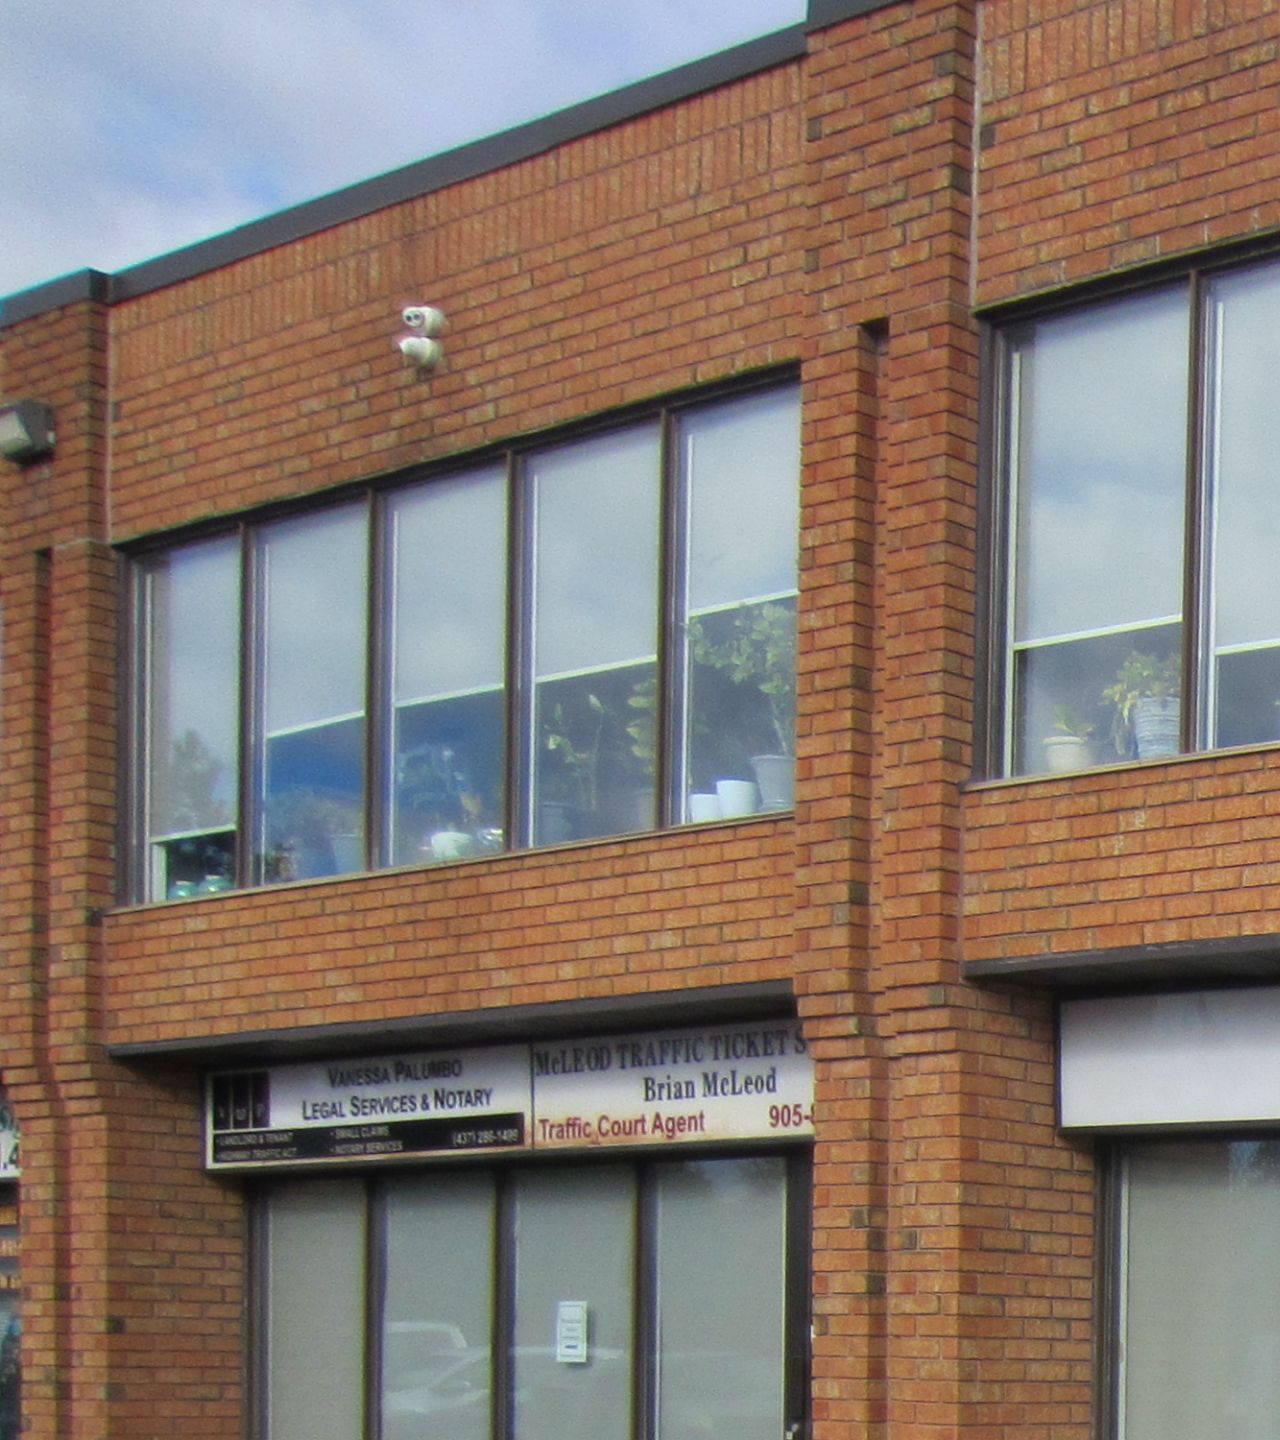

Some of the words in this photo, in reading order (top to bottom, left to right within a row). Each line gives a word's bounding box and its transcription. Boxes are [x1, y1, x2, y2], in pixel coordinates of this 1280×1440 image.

[536, 1048, 611, 1076] McLEOD
[618, 1036, 704, 1069] TRAFFIC
[711, 1028, 789, 1060] TICKET
[328, 1066, 391, 1088] VANESSA
[394, 1059, 463, 1083] PALUMBO
[643, 1075, 696, 1102] Brian
[702, 1066, 777, 1098] McLeod
[302, 1100, 346, 1120] LEGAL
[350, 1094, 417, 1117] SERVICES
[420, 1093, 430, 1111] &
[434, 1088, 493, 1110] NOTARY
[539, 1116, 591, 1141] Traffic
[597, 1112, 647, 1138] Court
[651, 1110, 705, 1139] Agent
